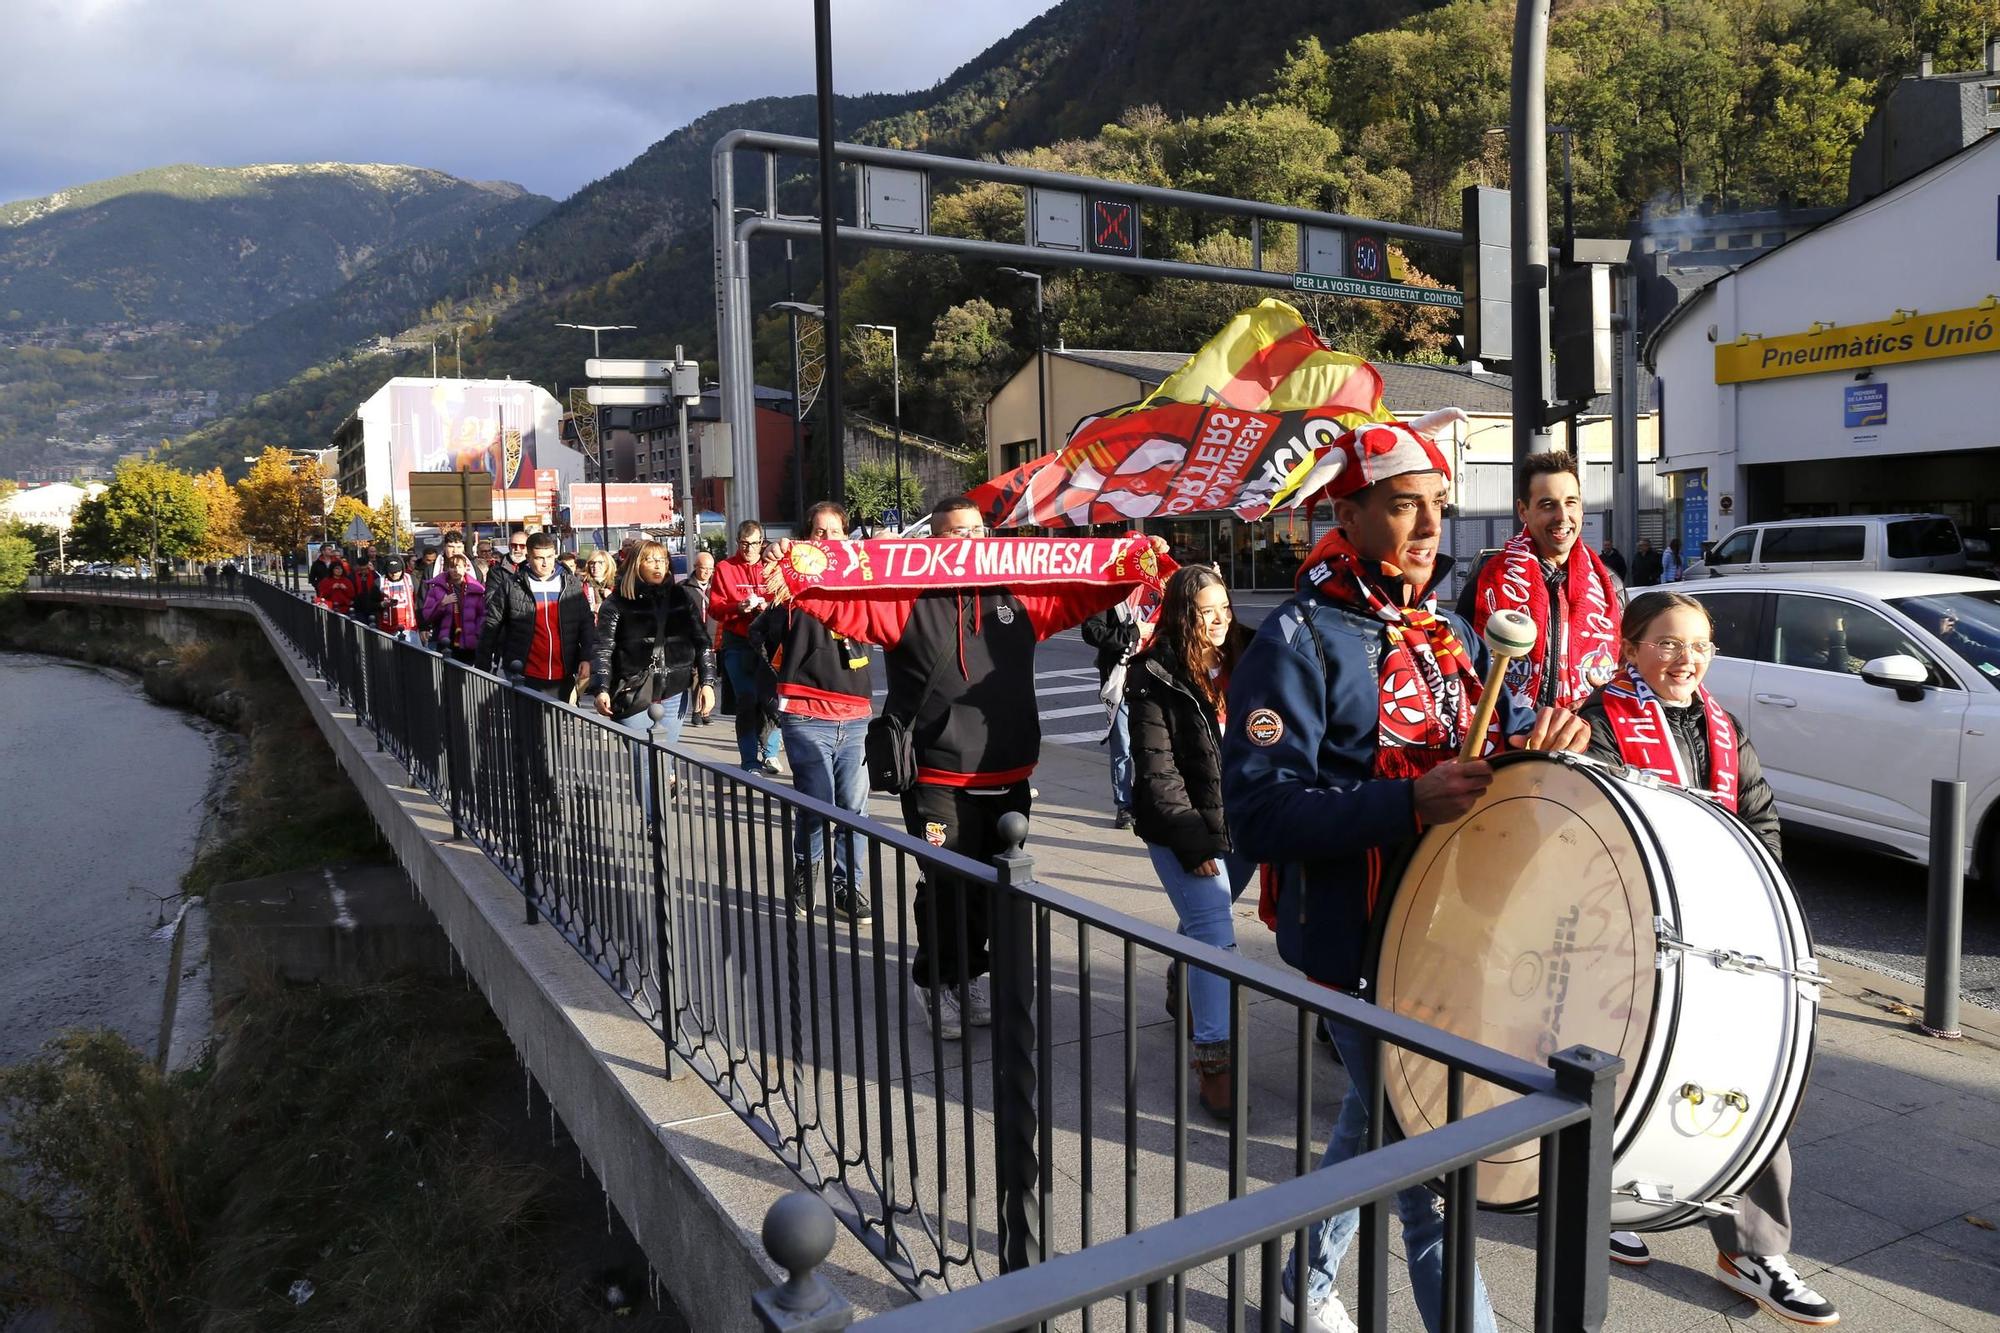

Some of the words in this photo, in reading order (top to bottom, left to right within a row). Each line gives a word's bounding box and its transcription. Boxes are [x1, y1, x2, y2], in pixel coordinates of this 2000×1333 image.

[1357, 246, 1377, 271] 50
[1295, 276, 1315, 289] PER
[1317, 278, 1329, 290] LA
[1331, 280, 1368, 295] VOSTRA
[1370, 285, 1420, 300] SEGURETAT
[1424, 292, 1464, 306] CONTROL
[1761, 333, 1914, 369] Pneumàtics
[1924, 317, 1993, 347] Unió
[858, 549, 874, 581] ACB
[974, 542, 1094, 576] MANRESA
[1115, 548, 1128, 577] ACB
